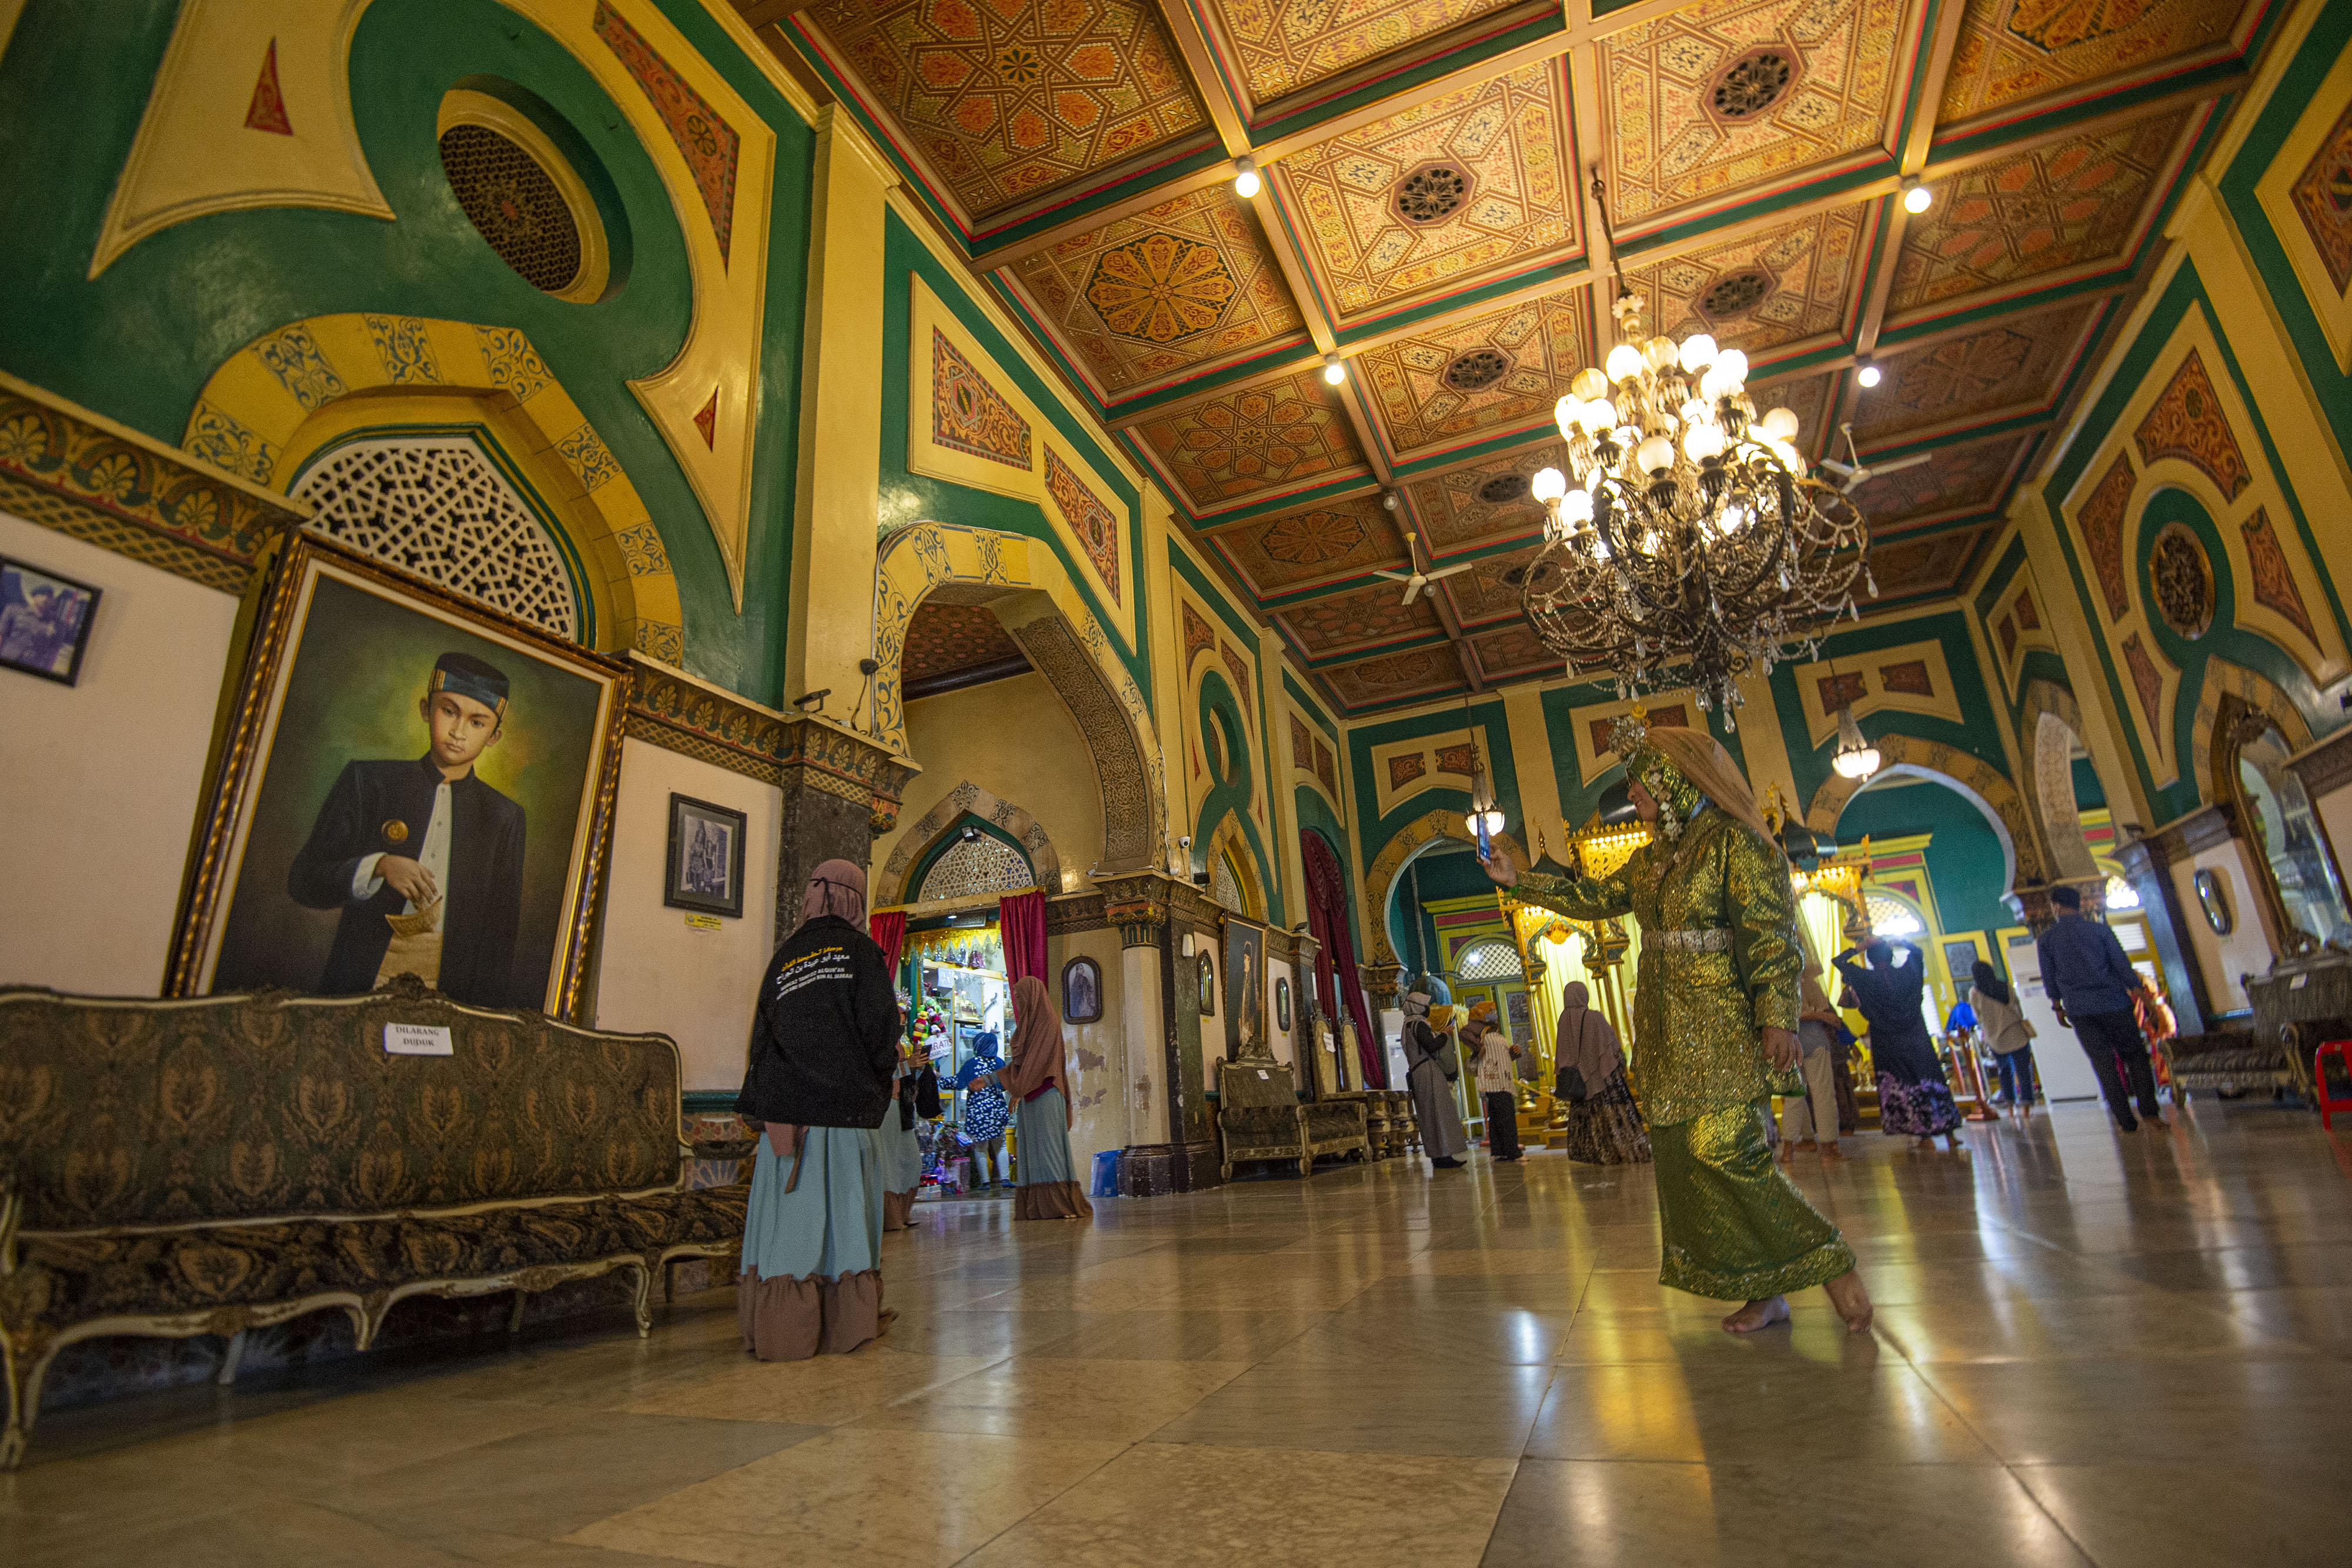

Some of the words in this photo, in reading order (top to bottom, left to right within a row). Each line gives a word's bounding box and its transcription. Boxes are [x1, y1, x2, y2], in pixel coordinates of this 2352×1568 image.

[396, 1025, 439, 1037] DILARANG
[403, 1038, 435, 1046] DUDUK
[931, 1038, 953, 1051] RATIS
